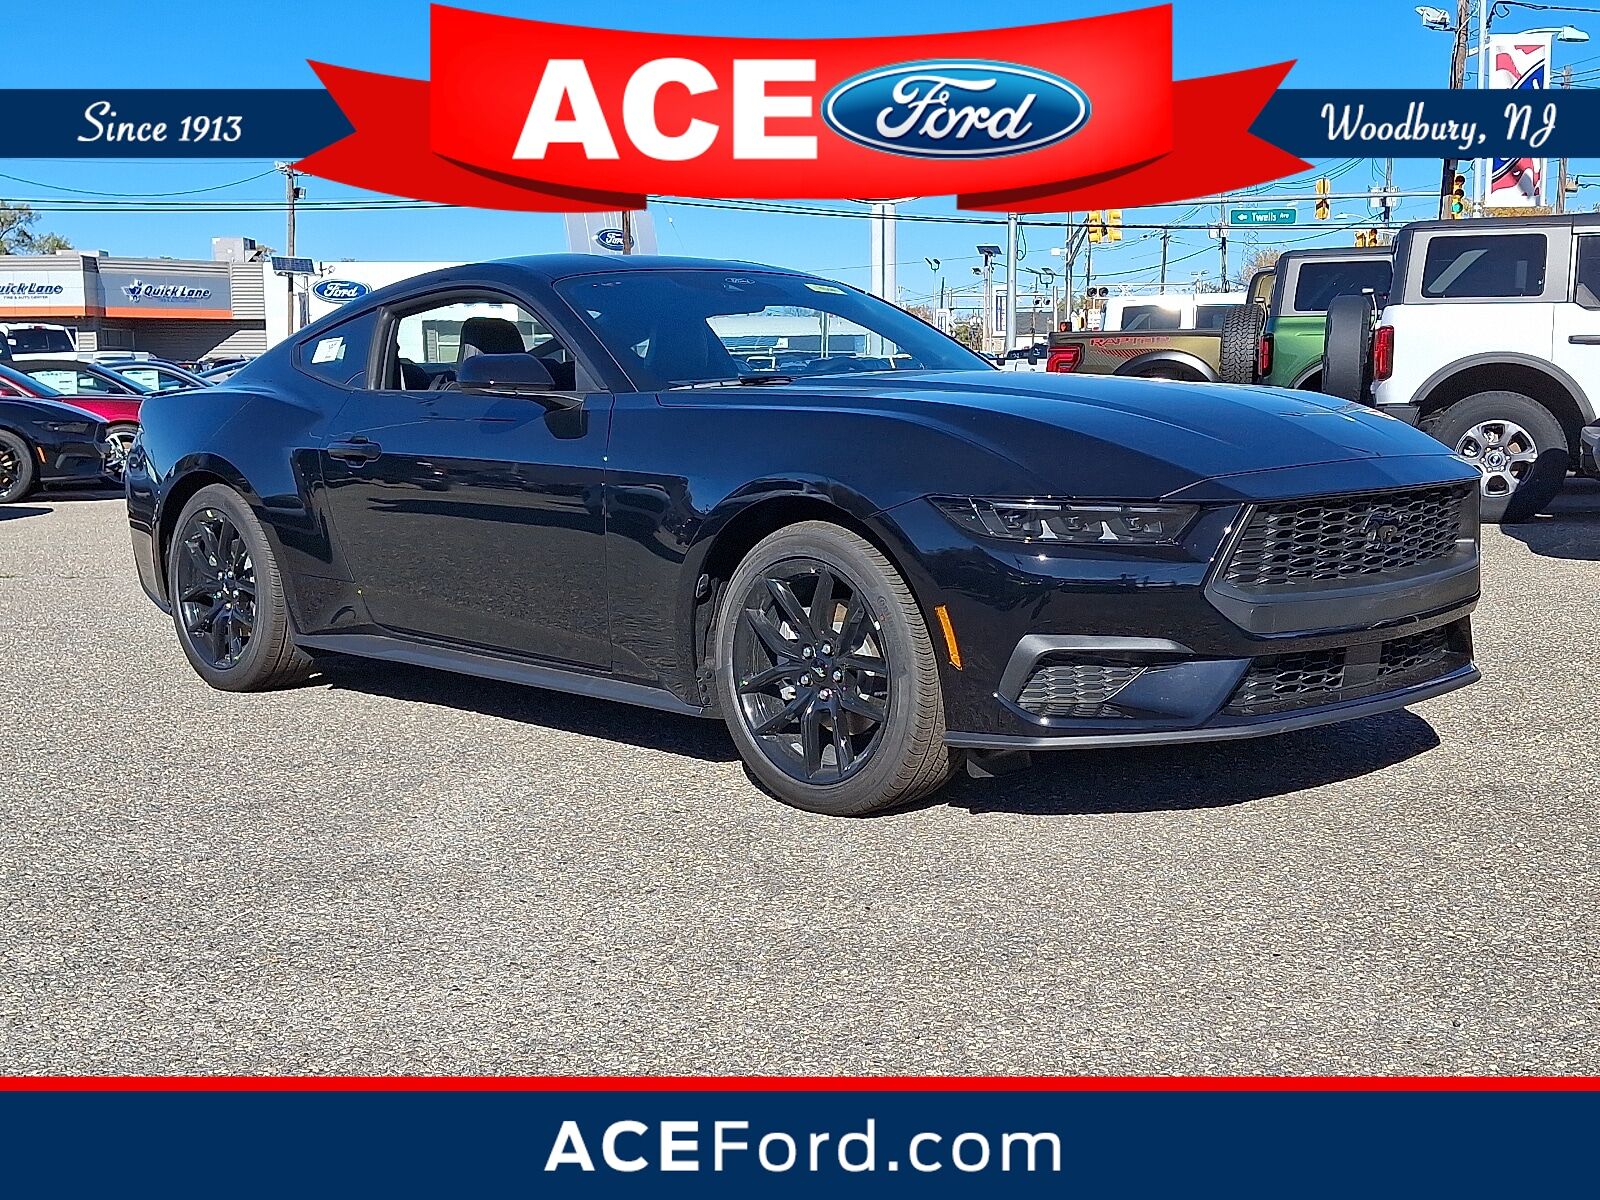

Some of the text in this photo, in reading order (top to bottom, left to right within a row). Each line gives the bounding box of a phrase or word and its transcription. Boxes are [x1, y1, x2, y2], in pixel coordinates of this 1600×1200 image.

[1251, 212, 1277, 222] Twells
[0, 283, 63, 294] uick Lane
[144, 285, 211, 298] Quick Lane
[323, 282, 359, 297] Ford
